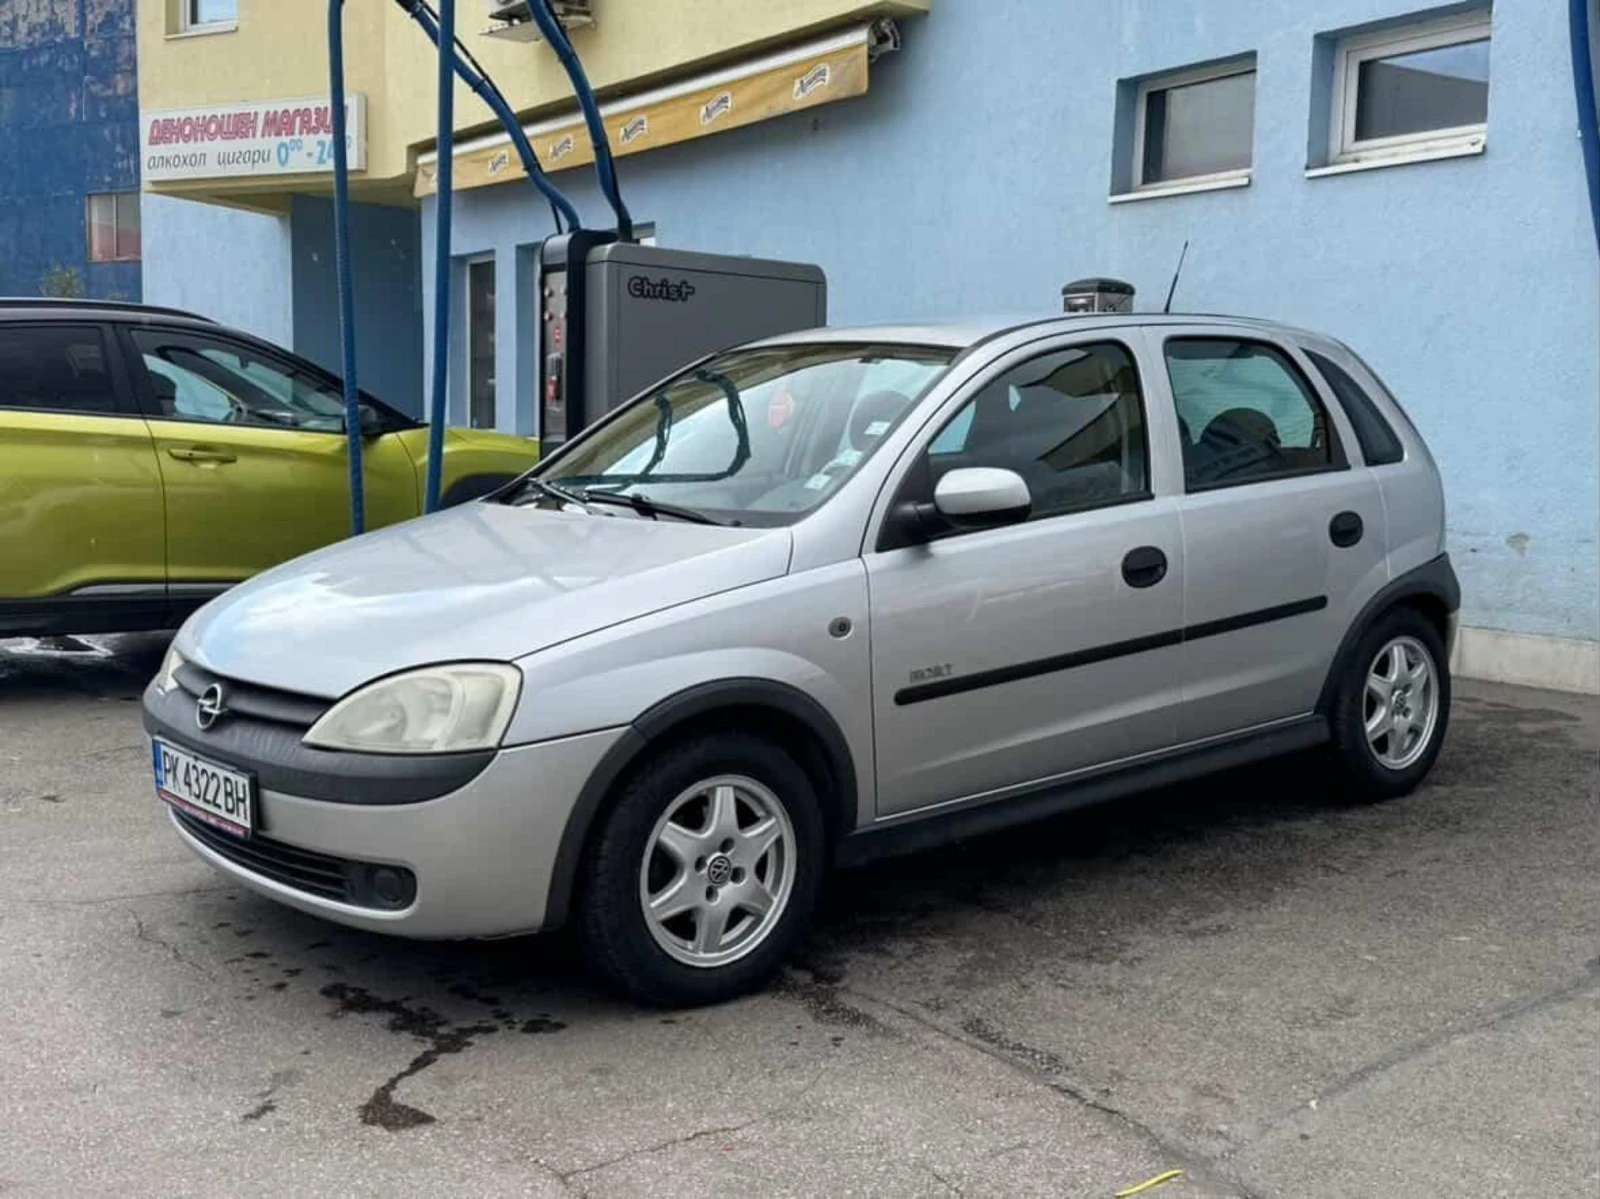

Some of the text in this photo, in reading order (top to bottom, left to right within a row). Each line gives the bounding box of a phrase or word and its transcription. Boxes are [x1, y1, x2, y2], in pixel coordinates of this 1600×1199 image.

[147, 153, 207, 170] алкохол
[217, 149, 271, 170] цигари
[628, 276, 696, 302] Christ
